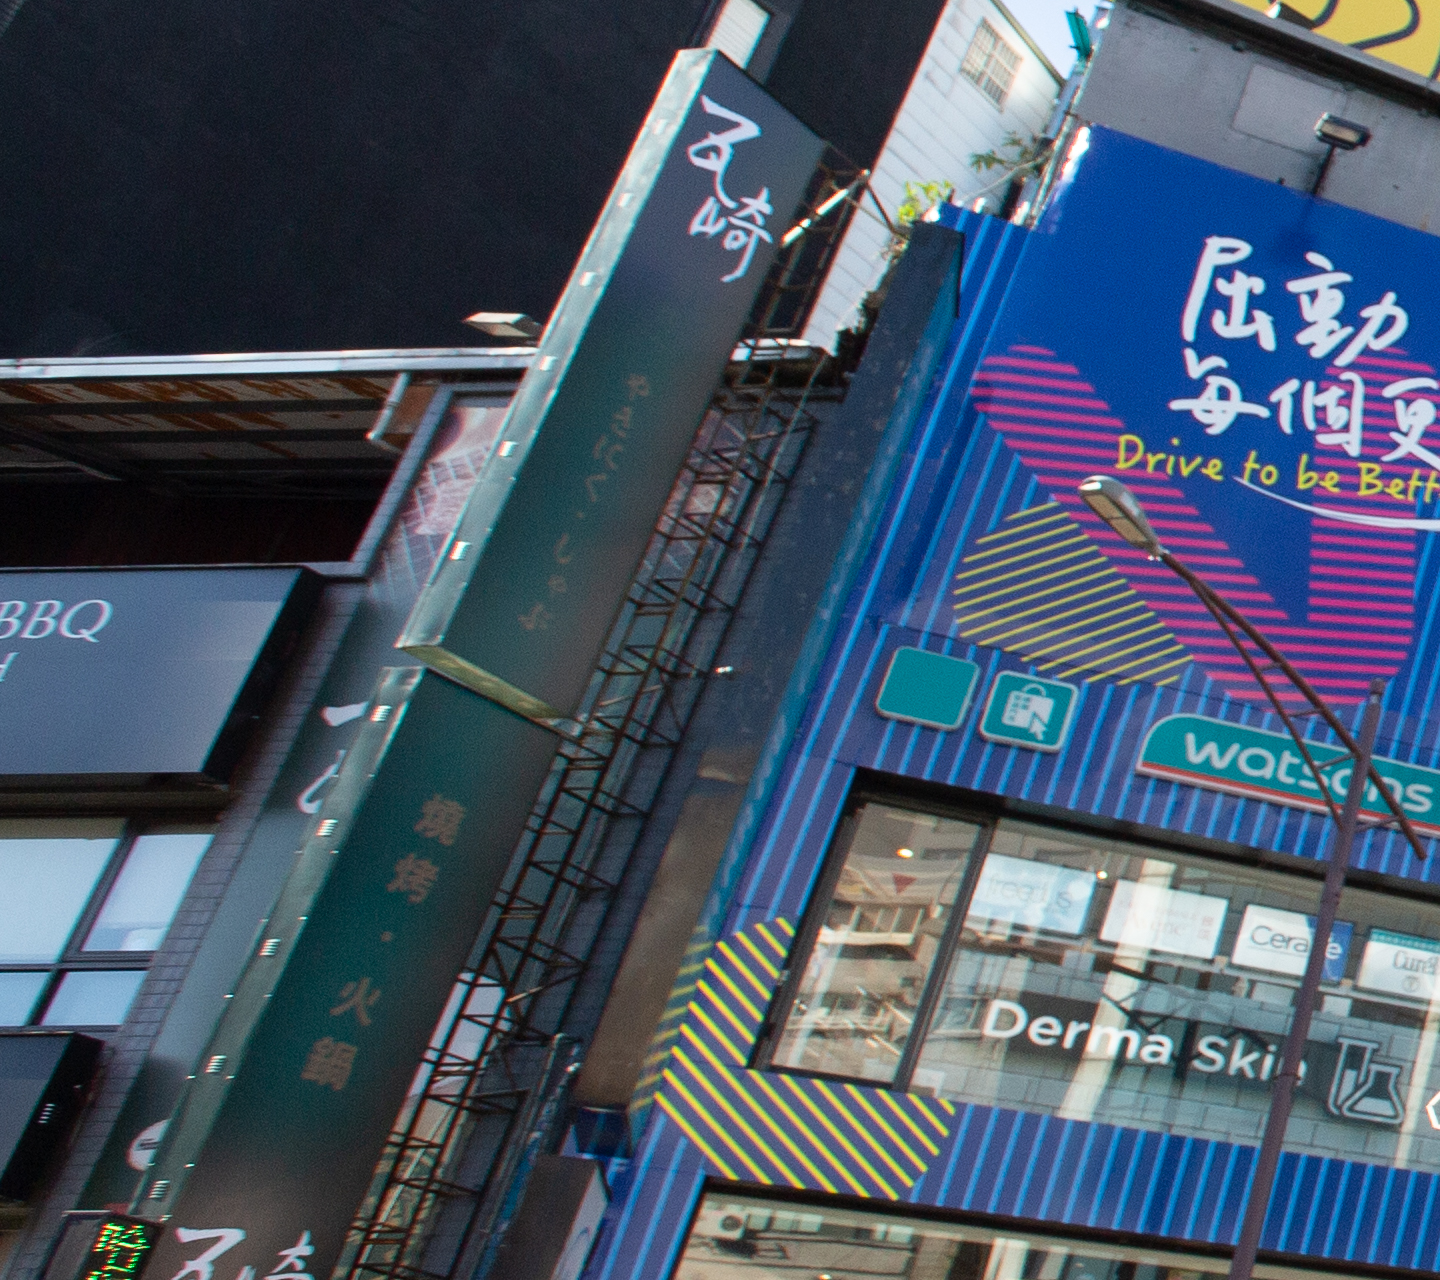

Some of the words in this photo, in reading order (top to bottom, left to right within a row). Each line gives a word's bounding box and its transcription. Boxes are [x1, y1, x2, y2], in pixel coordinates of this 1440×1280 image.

[1183, 235, 1409, 366] 屈動
[1117, 434, 1224, 482] Drive
[1242, 450, 1278, 487] to
[1298, 452, 1340, 495] be
[1250, 922, 1344, 962] Cerae
[983, 1000, 1174, 1068] Derma
